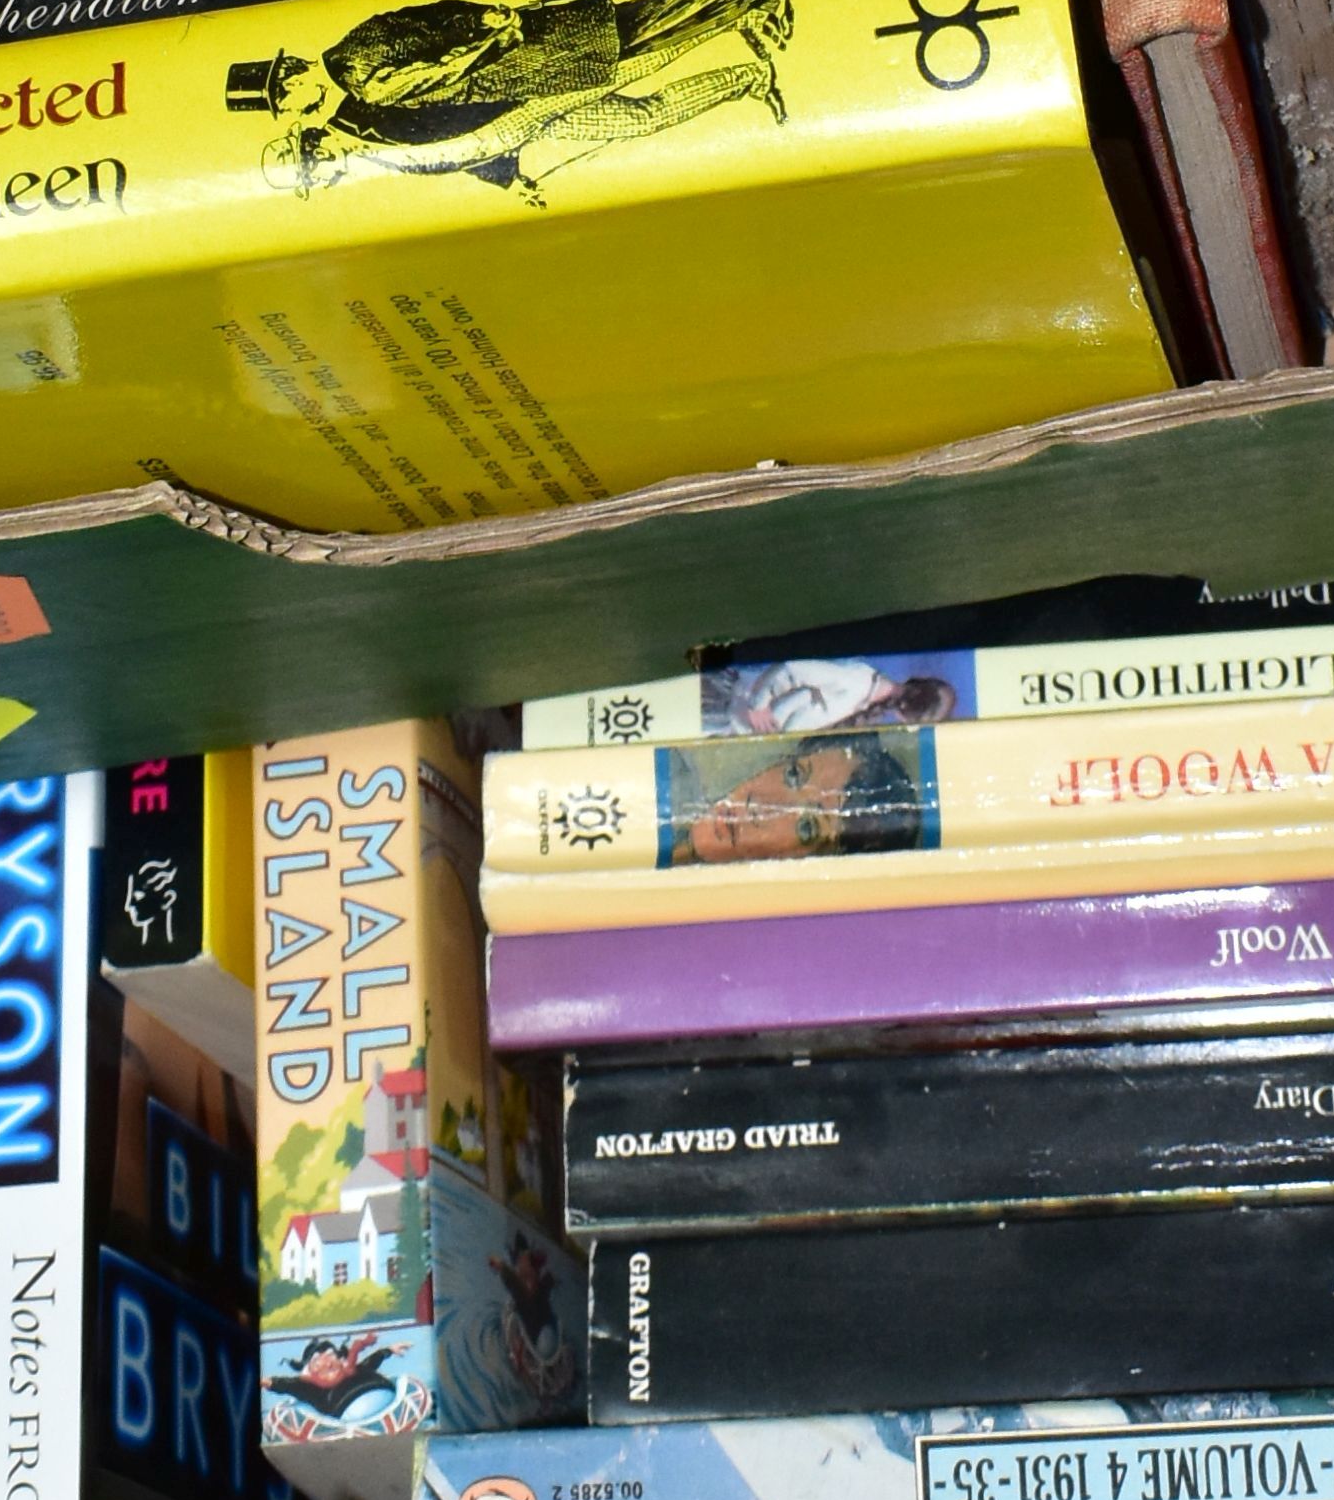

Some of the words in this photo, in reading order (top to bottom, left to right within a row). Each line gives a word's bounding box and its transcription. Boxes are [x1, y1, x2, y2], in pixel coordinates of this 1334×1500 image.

[1047, 744, 1282, 809] WOOLF
[264, 748, 339, 1106] ISLAND
[337, 761, 413, 1086] SMALL
[1209, 919, 1334, 967] Woolf
[594, 1125, 737, 1159] GRAFTON
[744, 1120, 840, 1151] TRIAD
[7, 1248, 59, 1401] Notes
[627, 1250, 652, 1402] GRAFTON
